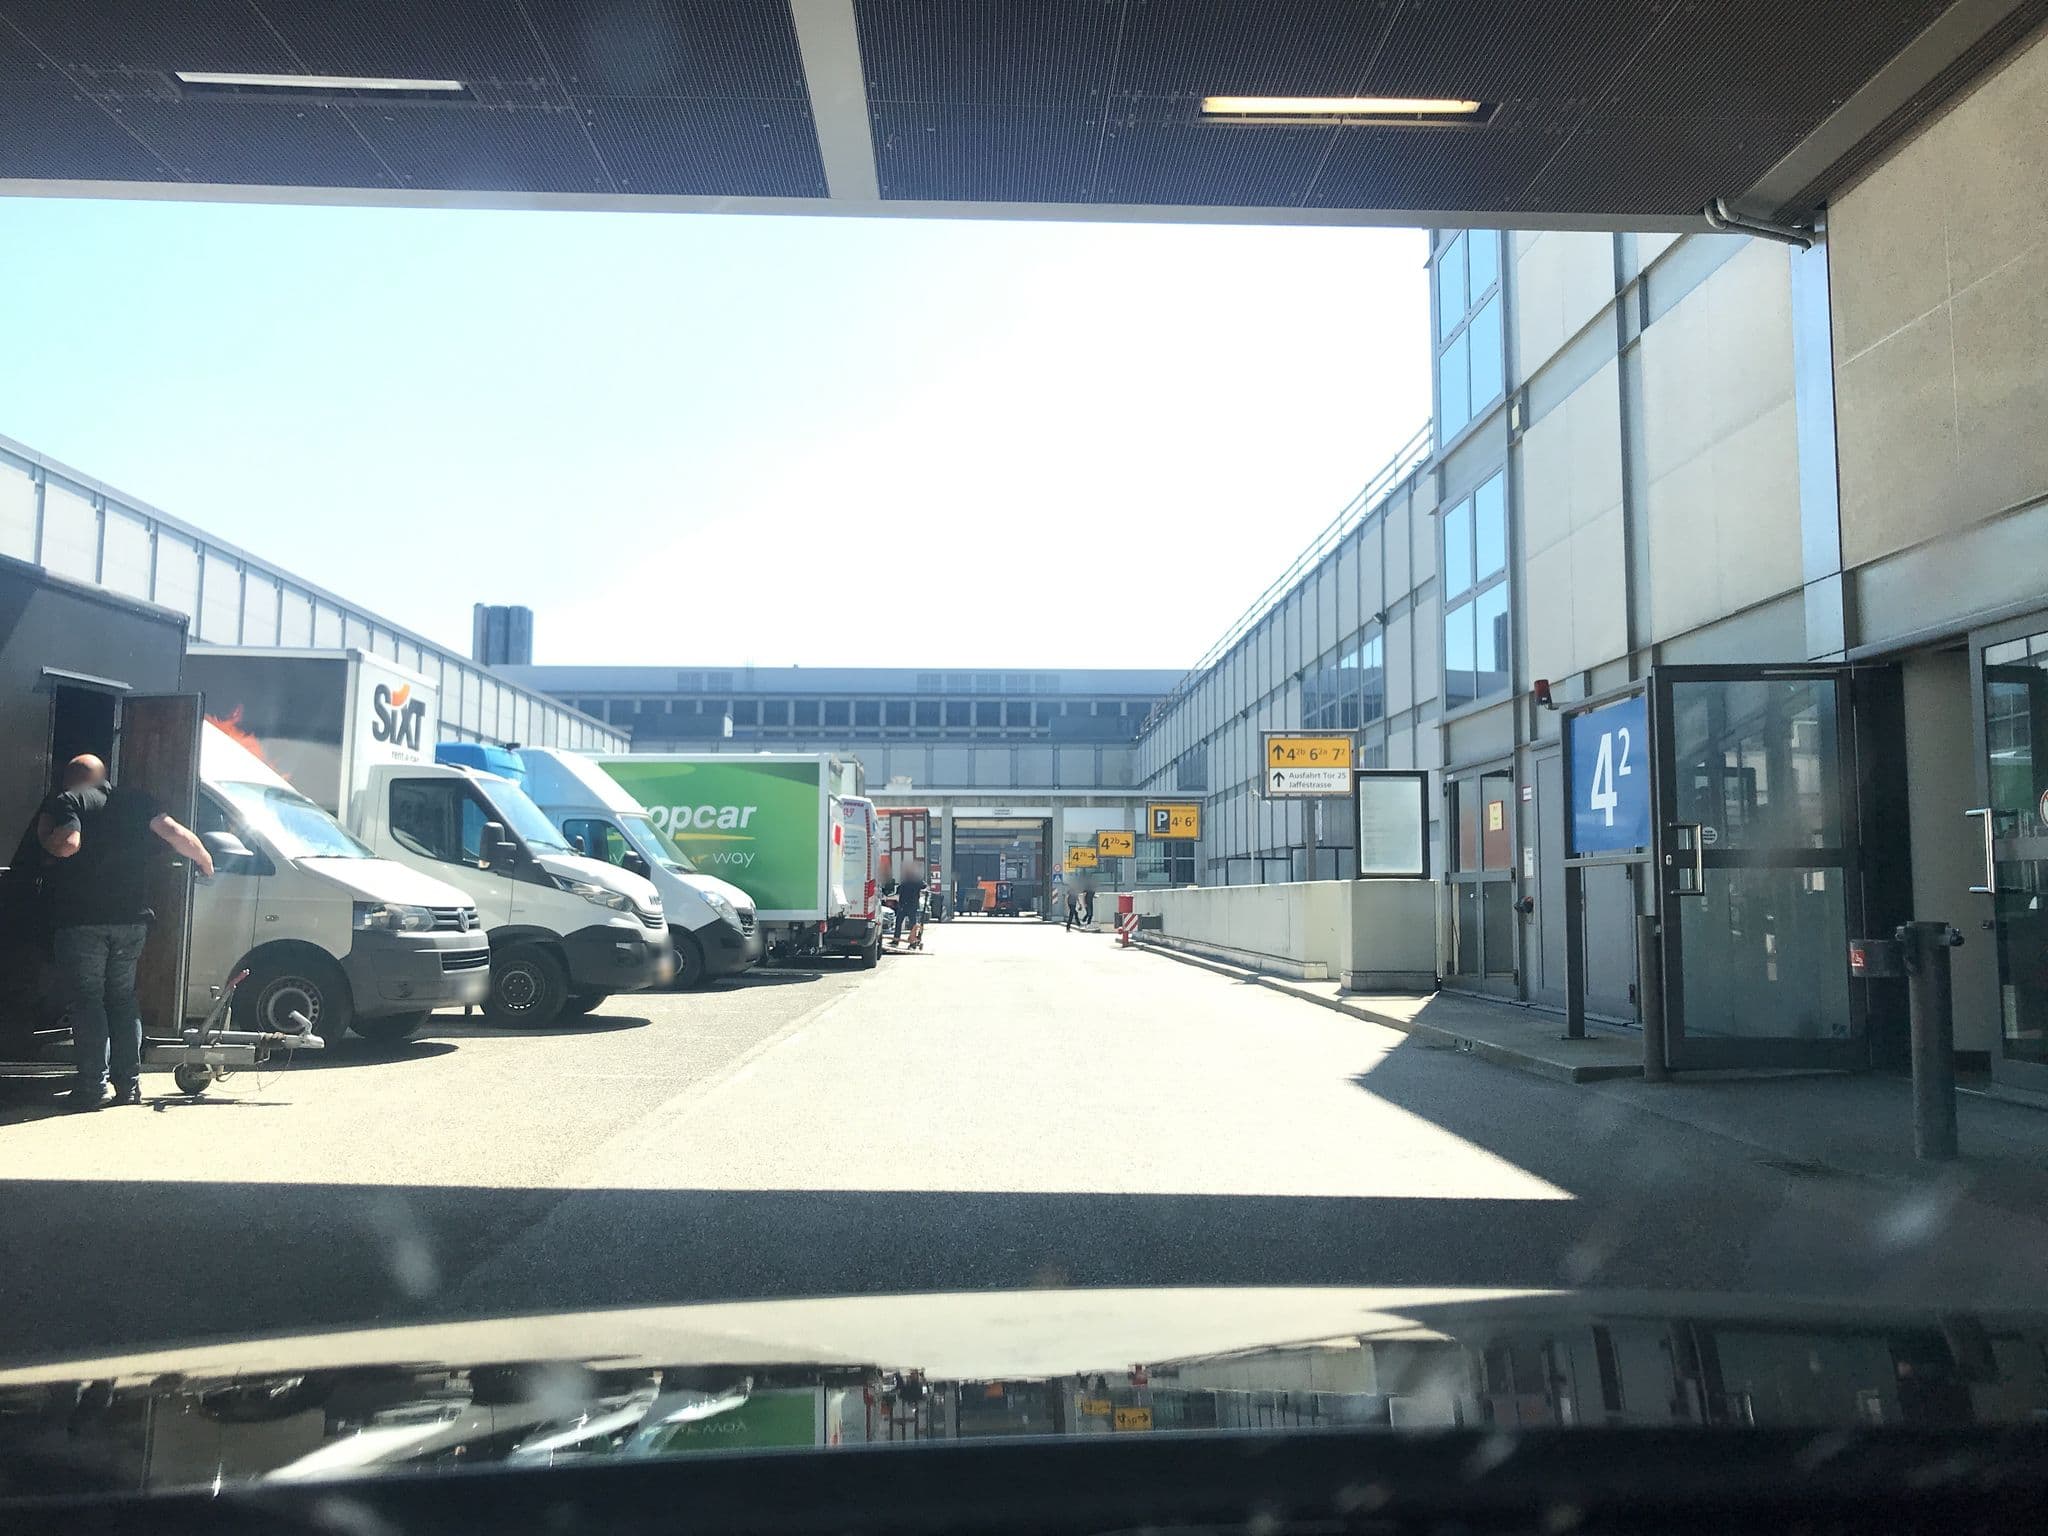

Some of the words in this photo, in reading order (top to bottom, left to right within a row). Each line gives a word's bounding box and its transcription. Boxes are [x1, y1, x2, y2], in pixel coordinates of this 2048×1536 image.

[1289, 772, 1321, 780] Ausfahrt
[643, 805, 757, 840] opcar
[1156, 811, 1168, 827] P
[712, 852, 755, 868] way
